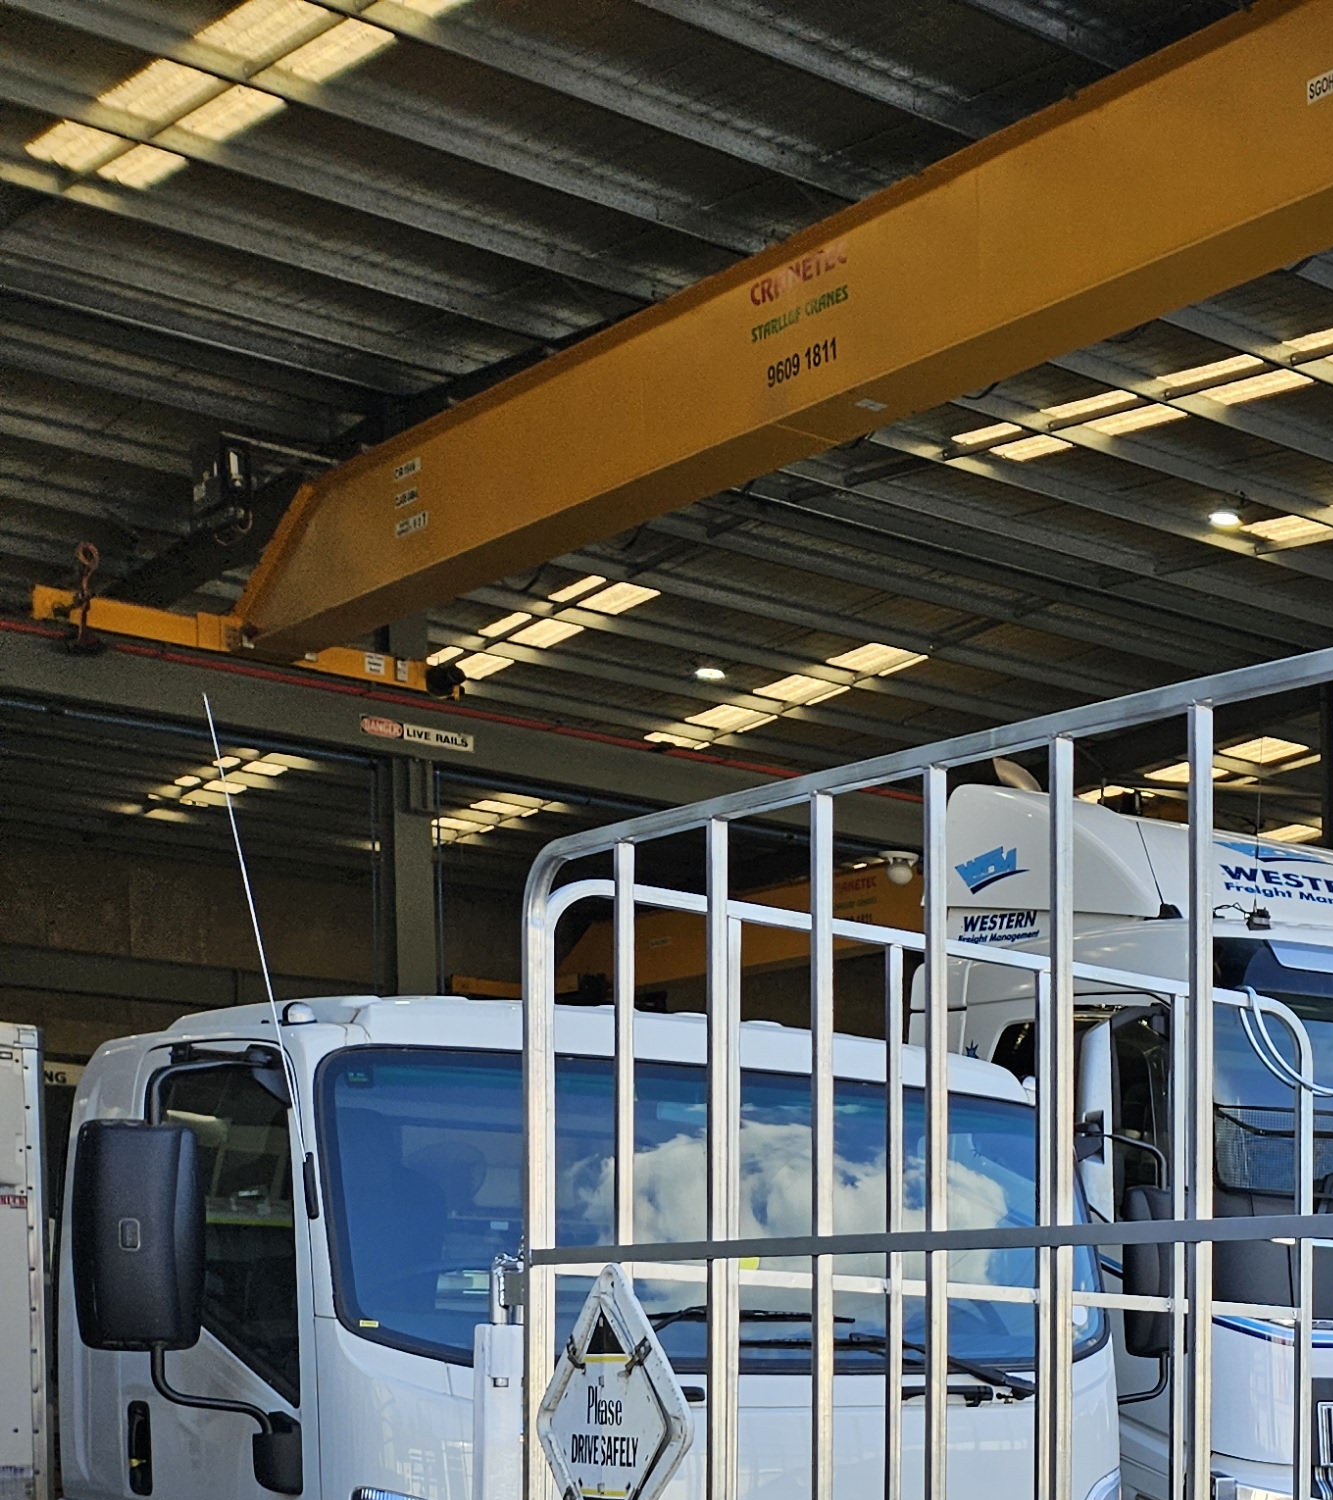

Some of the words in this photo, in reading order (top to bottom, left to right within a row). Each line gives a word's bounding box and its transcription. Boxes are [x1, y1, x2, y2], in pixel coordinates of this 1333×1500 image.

[804, 284, 849, 317] CRANES
[767, 353, 801, 388] 9609
[804, 336, 837, 370] 1811
[406, 728, 432, 740] LIVE
[435, 733, 469, 748] RAILS
[963, 909, 1038, 933] WESTERN
[988, 929, 1040, 943] Management
[586, 1385, 623, 1426] Please
[571, 1433, 600, 1465] DRIVE
[600, 1435, 639, 1468] SAFELY
